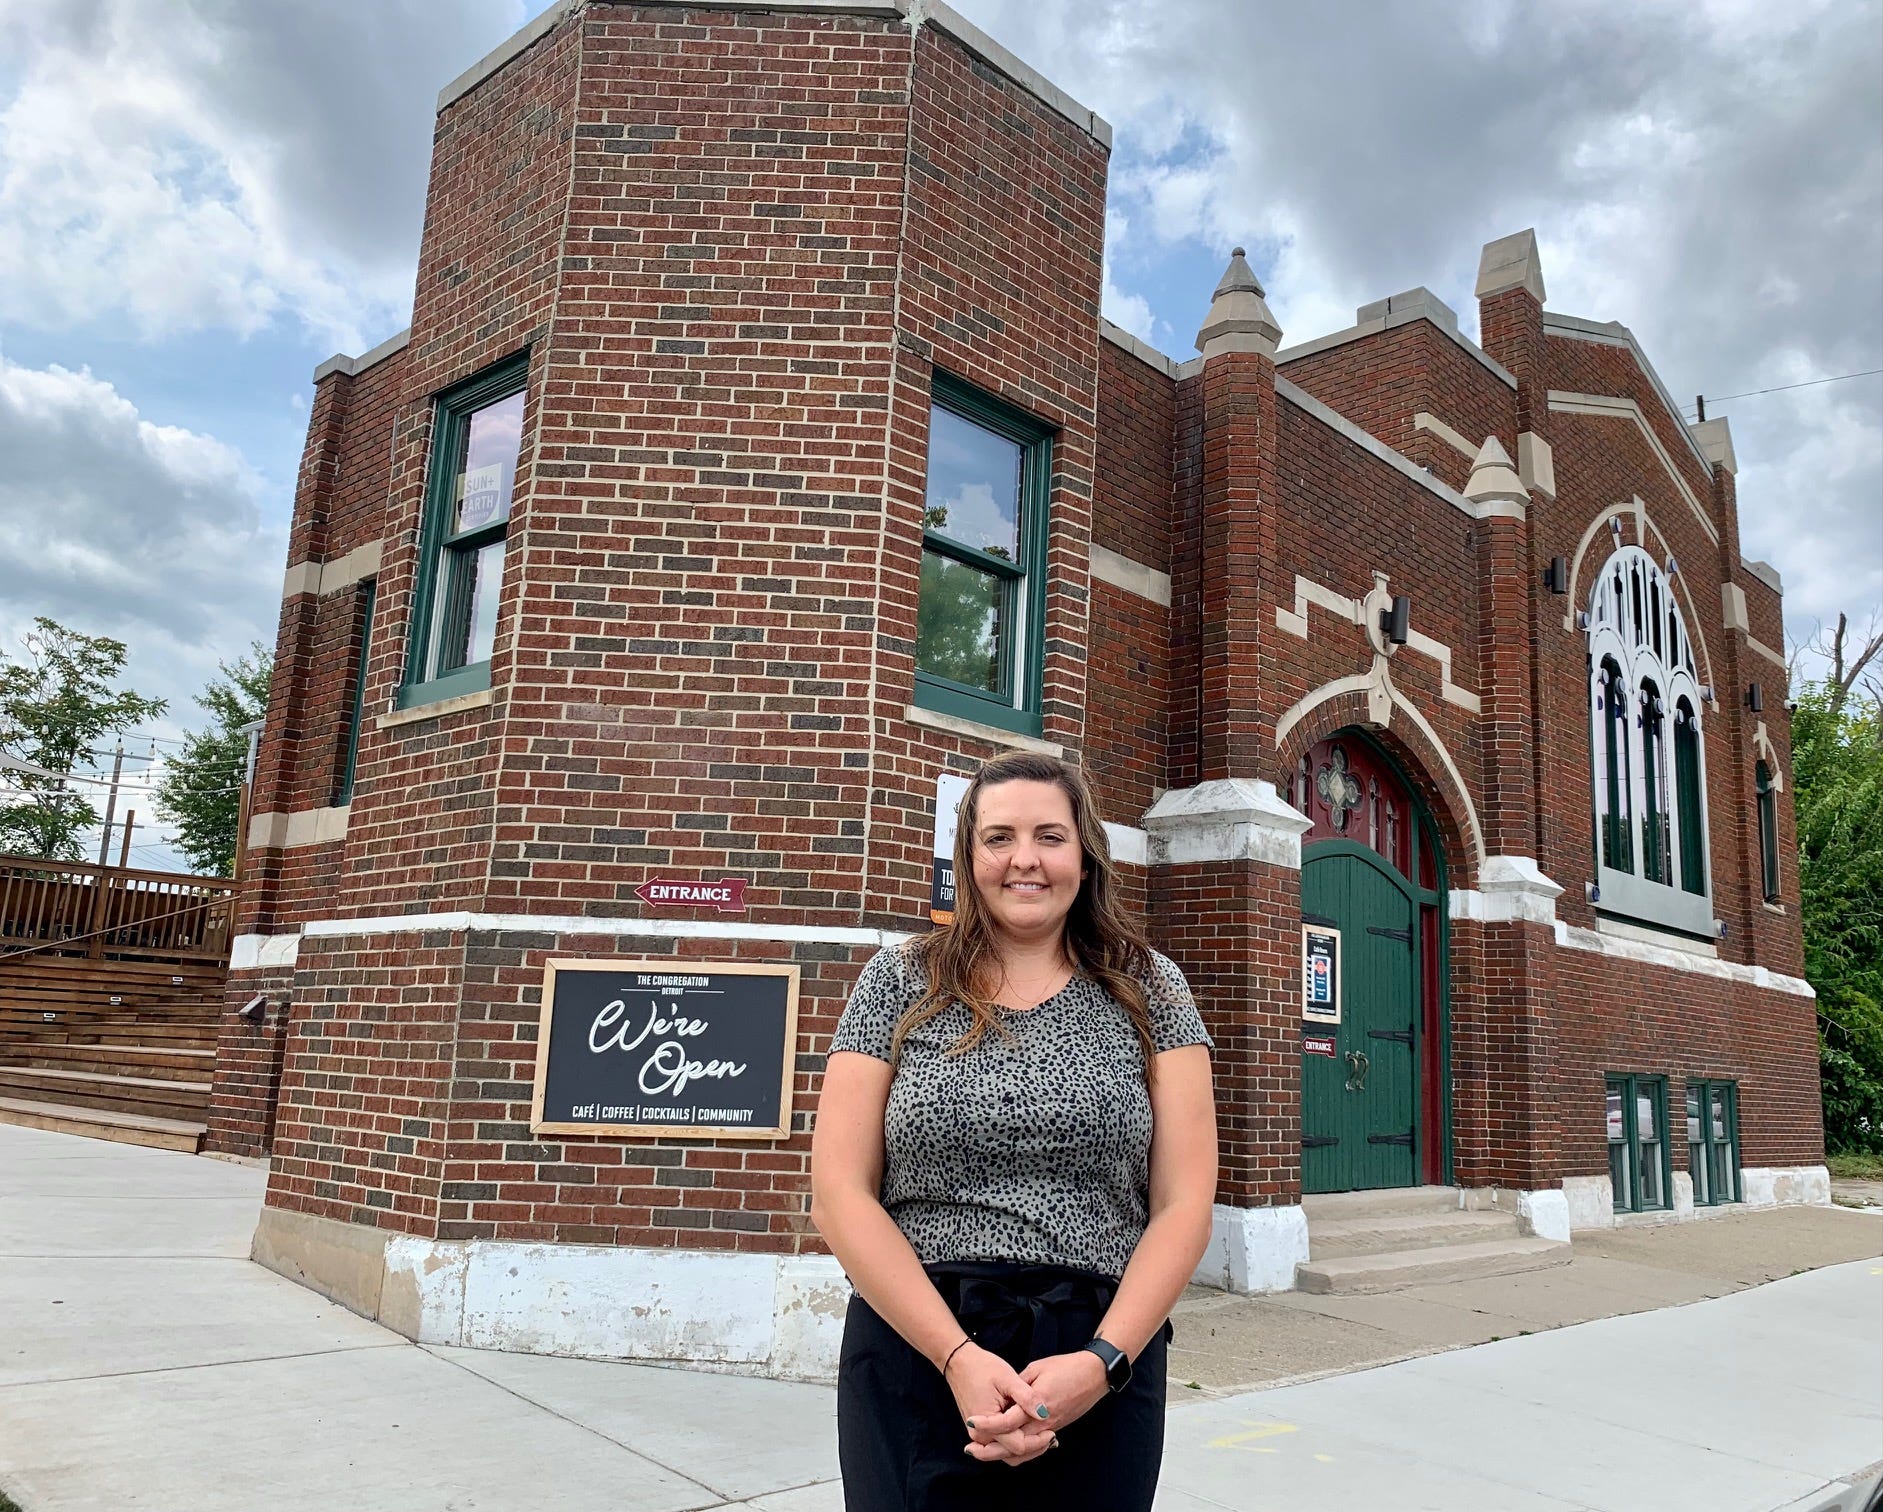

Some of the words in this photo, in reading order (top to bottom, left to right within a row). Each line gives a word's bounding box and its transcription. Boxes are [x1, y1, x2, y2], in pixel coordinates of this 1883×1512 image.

[466, 475, 494, 493] SUN+
[463, 495, 494, 512] EARTH
[941, 869, 955, 886] TO
[650, 886, 731, 901] ENTRANCE
[940, 887, 954, 900] FOR
[637, 975, 651, 985] THE
[652, 975, 709, 986] CONGREGATION
[661, 987, 684, 995] DETROIT
[588, 1000, 709, 1053] We're
[1305, 1041, 1332, 1051] ENTRANCE
[638, 1041, 747, 1096] Open
[572, 1104, 595, 1118] CAFÉ
[602, 1106, 634, 1119] COFFEE
[642, 1107, 690, 1120] COCKTAILS
[697, 1108, 753, 1122] COMMUNITY
